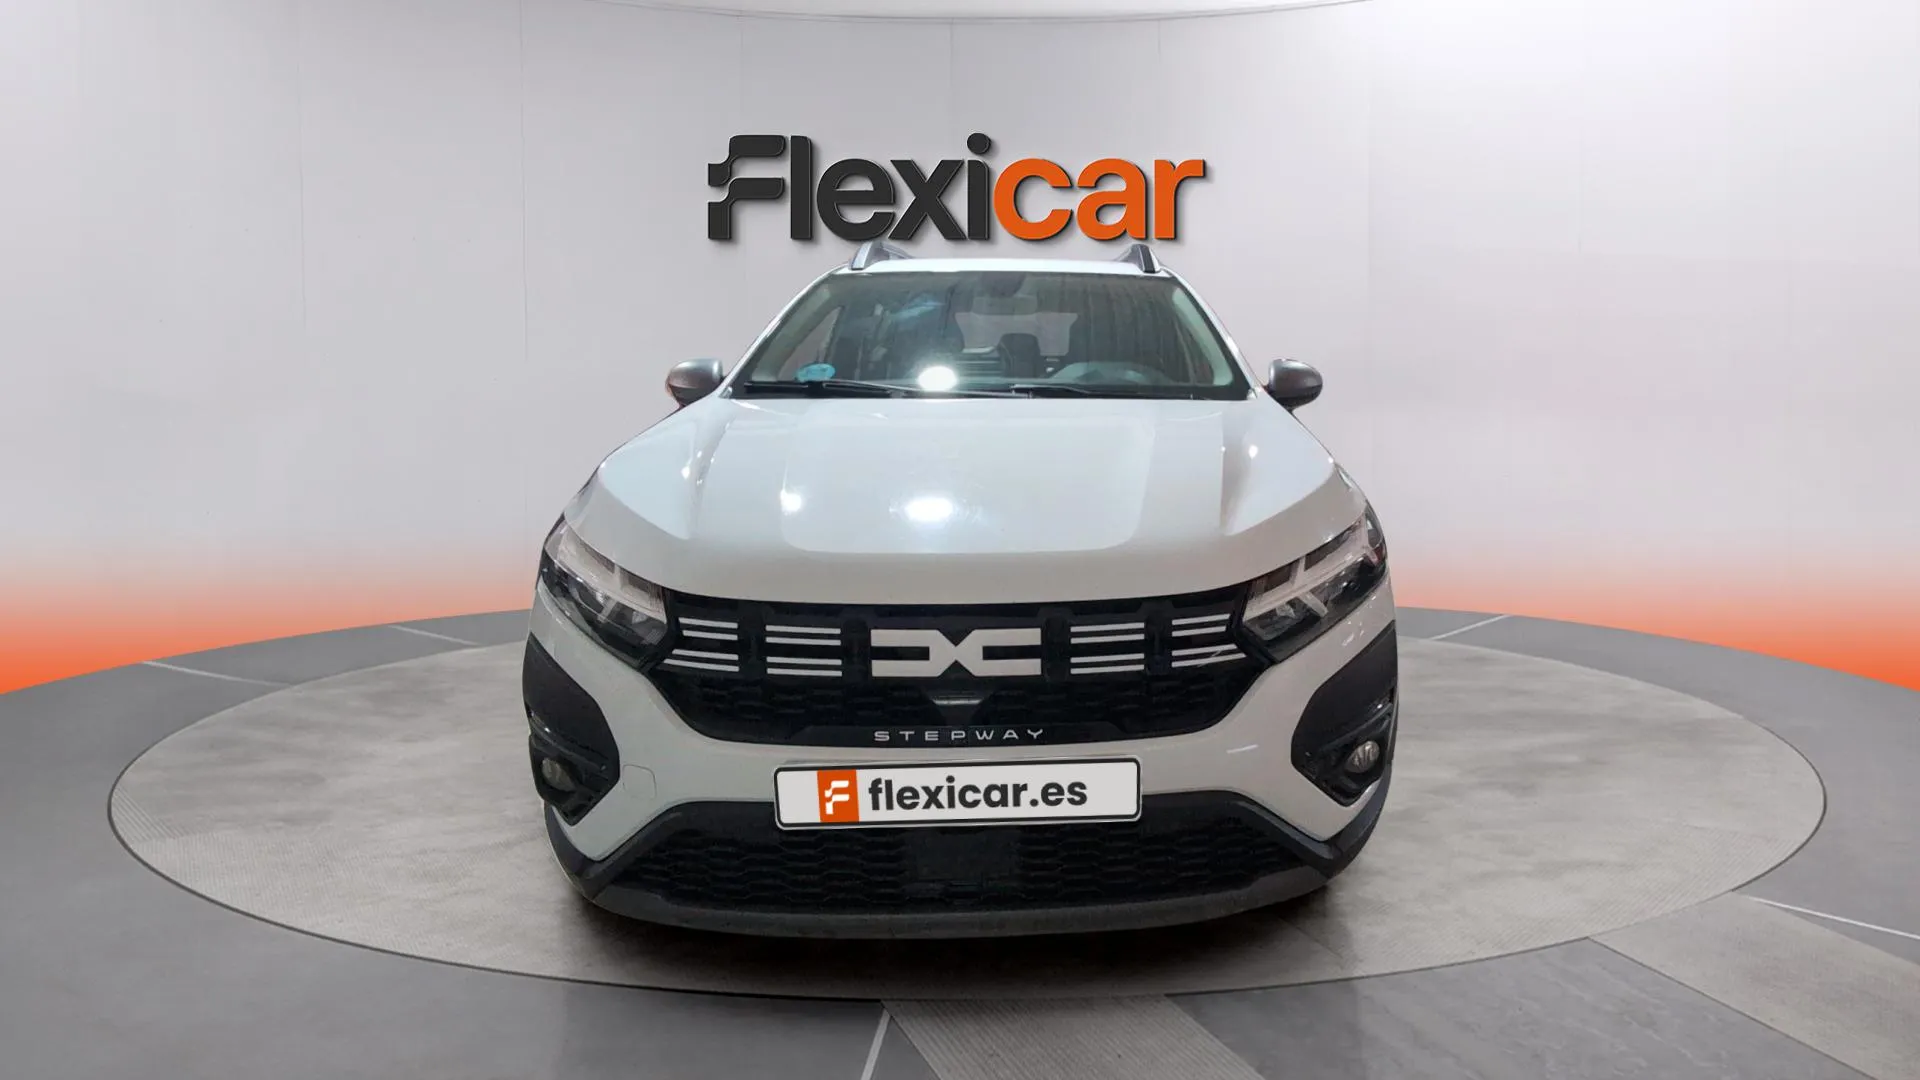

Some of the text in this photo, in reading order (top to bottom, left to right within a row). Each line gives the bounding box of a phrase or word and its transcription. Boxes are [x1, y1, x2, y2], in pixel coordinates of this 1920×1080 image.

[707, 132, 1206, 241] Flexicar
[873, 728, 1044, 742] STEPWAY
[868, 775, 1088, 811] flexicar.es
